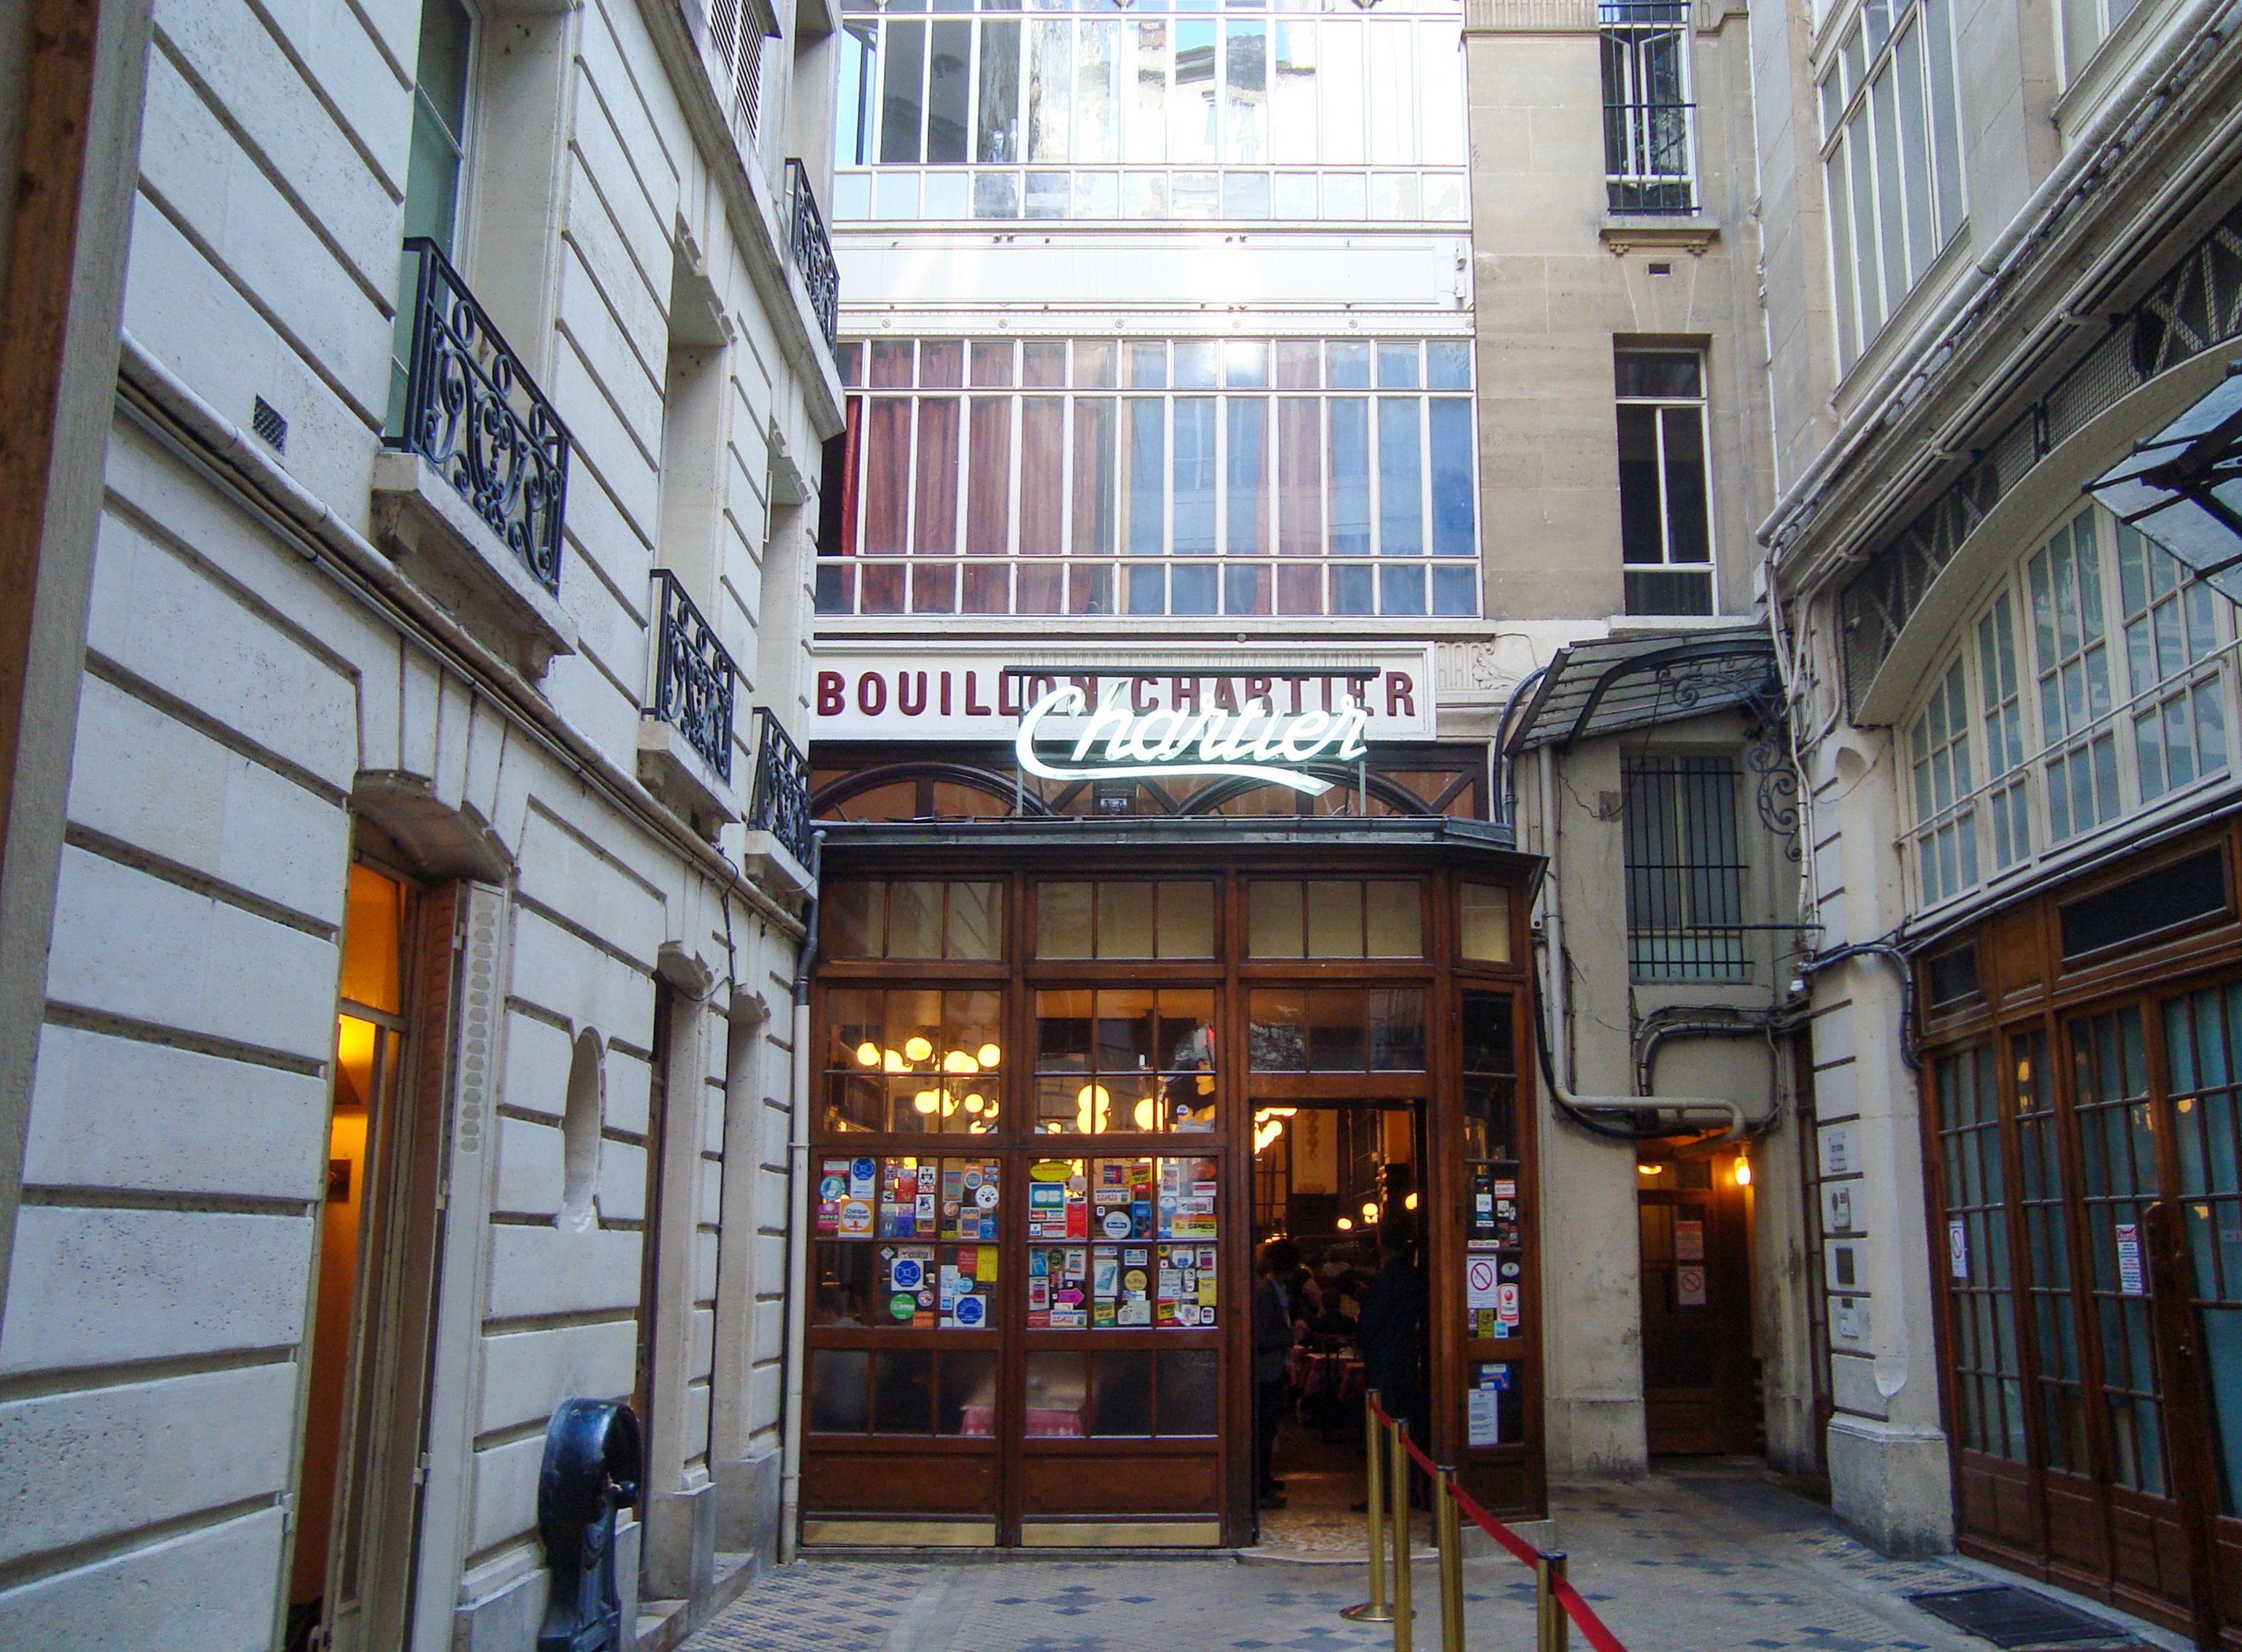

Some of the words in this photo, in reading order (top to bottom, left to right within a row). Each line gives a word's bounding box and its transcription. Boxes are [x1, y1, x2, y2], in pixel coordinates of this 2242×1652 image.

[817, 671, 1098, 717] BOUILLON
[1130, 670, 1416, 717] CHARTIER
[1014, 679, 1370, 796] Chartier
[1034, 1189, 1061, 1203] CB
